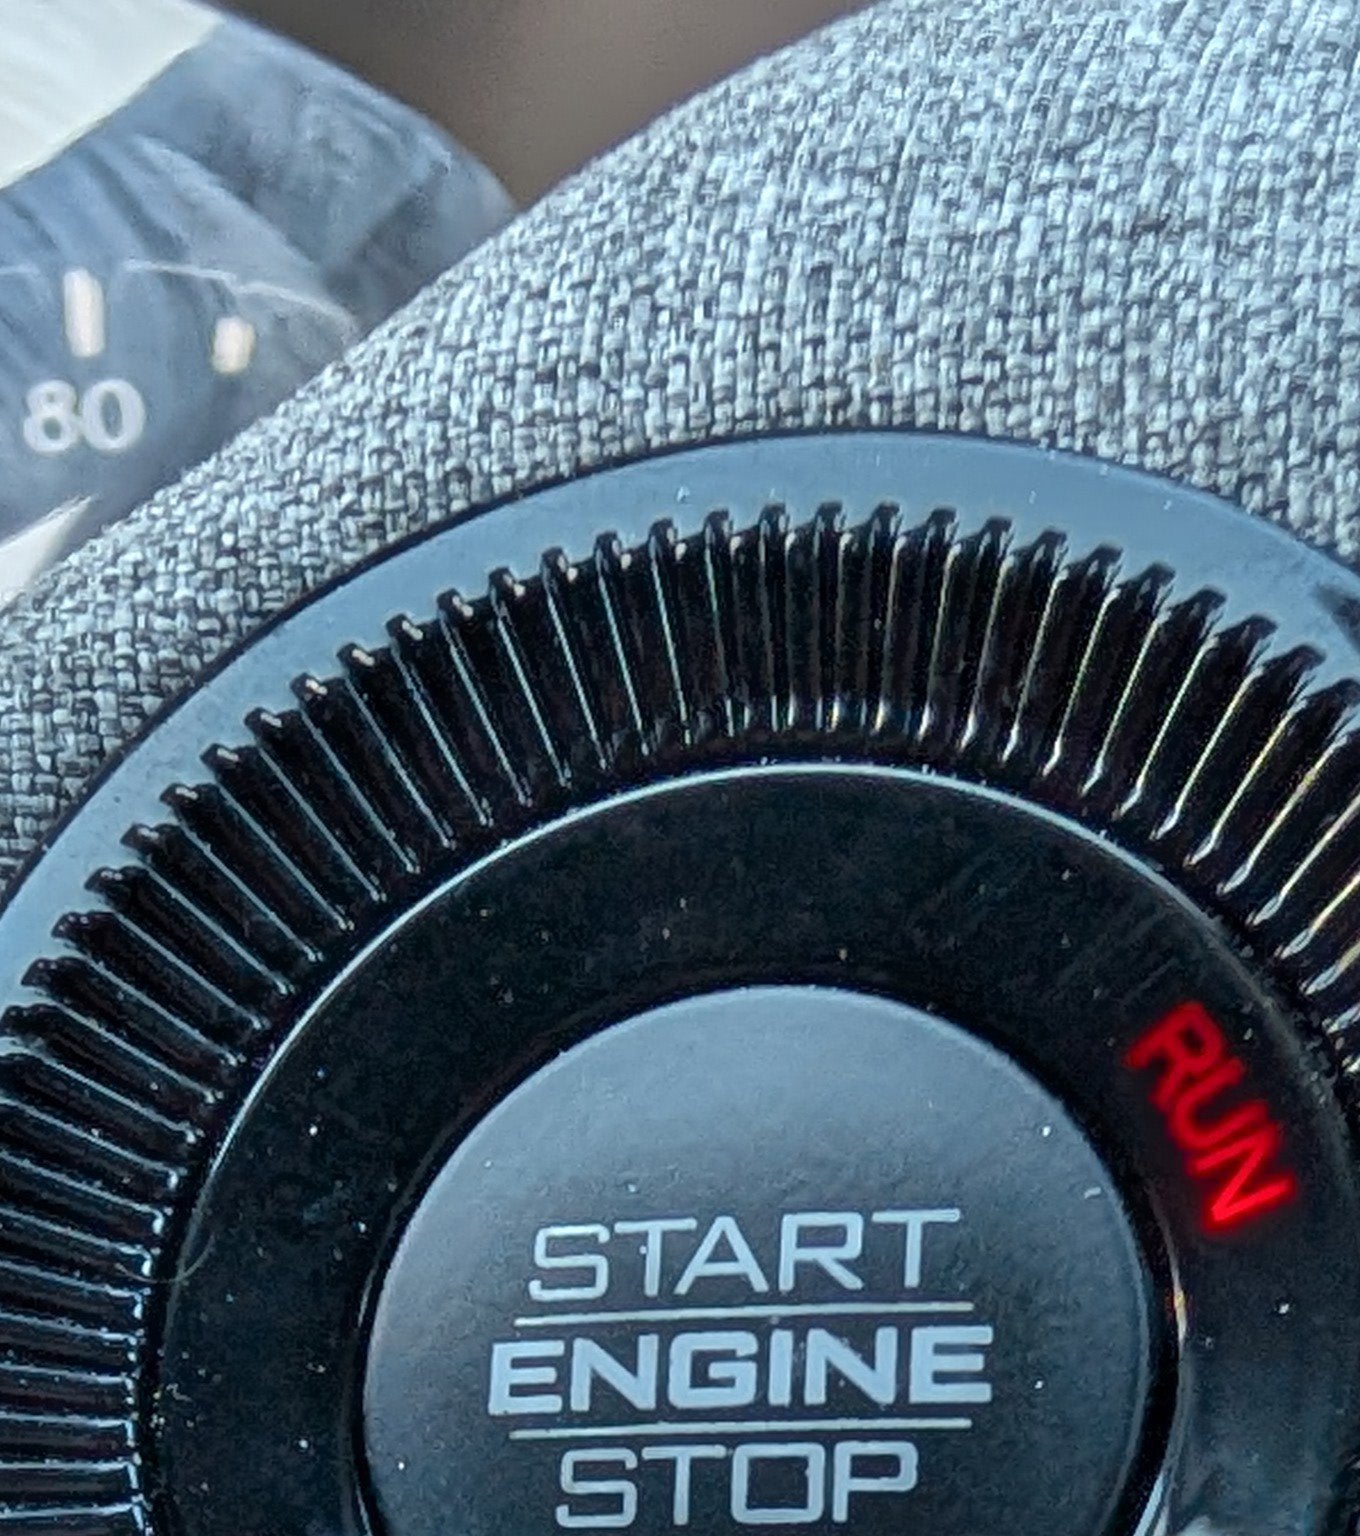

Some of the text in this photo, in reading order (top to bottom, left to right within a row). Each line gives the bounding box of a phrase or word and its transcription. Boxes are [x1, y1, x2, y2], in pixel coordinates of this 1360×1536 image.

[23, 379, 145, 453] 80
[1124, 1001, 1296, 1232] RUN
[529, 1208, 961, 1301] START
[488, 1325, 993, 1415] ENGINE
[556, 1441, 918, 1528] STOP
